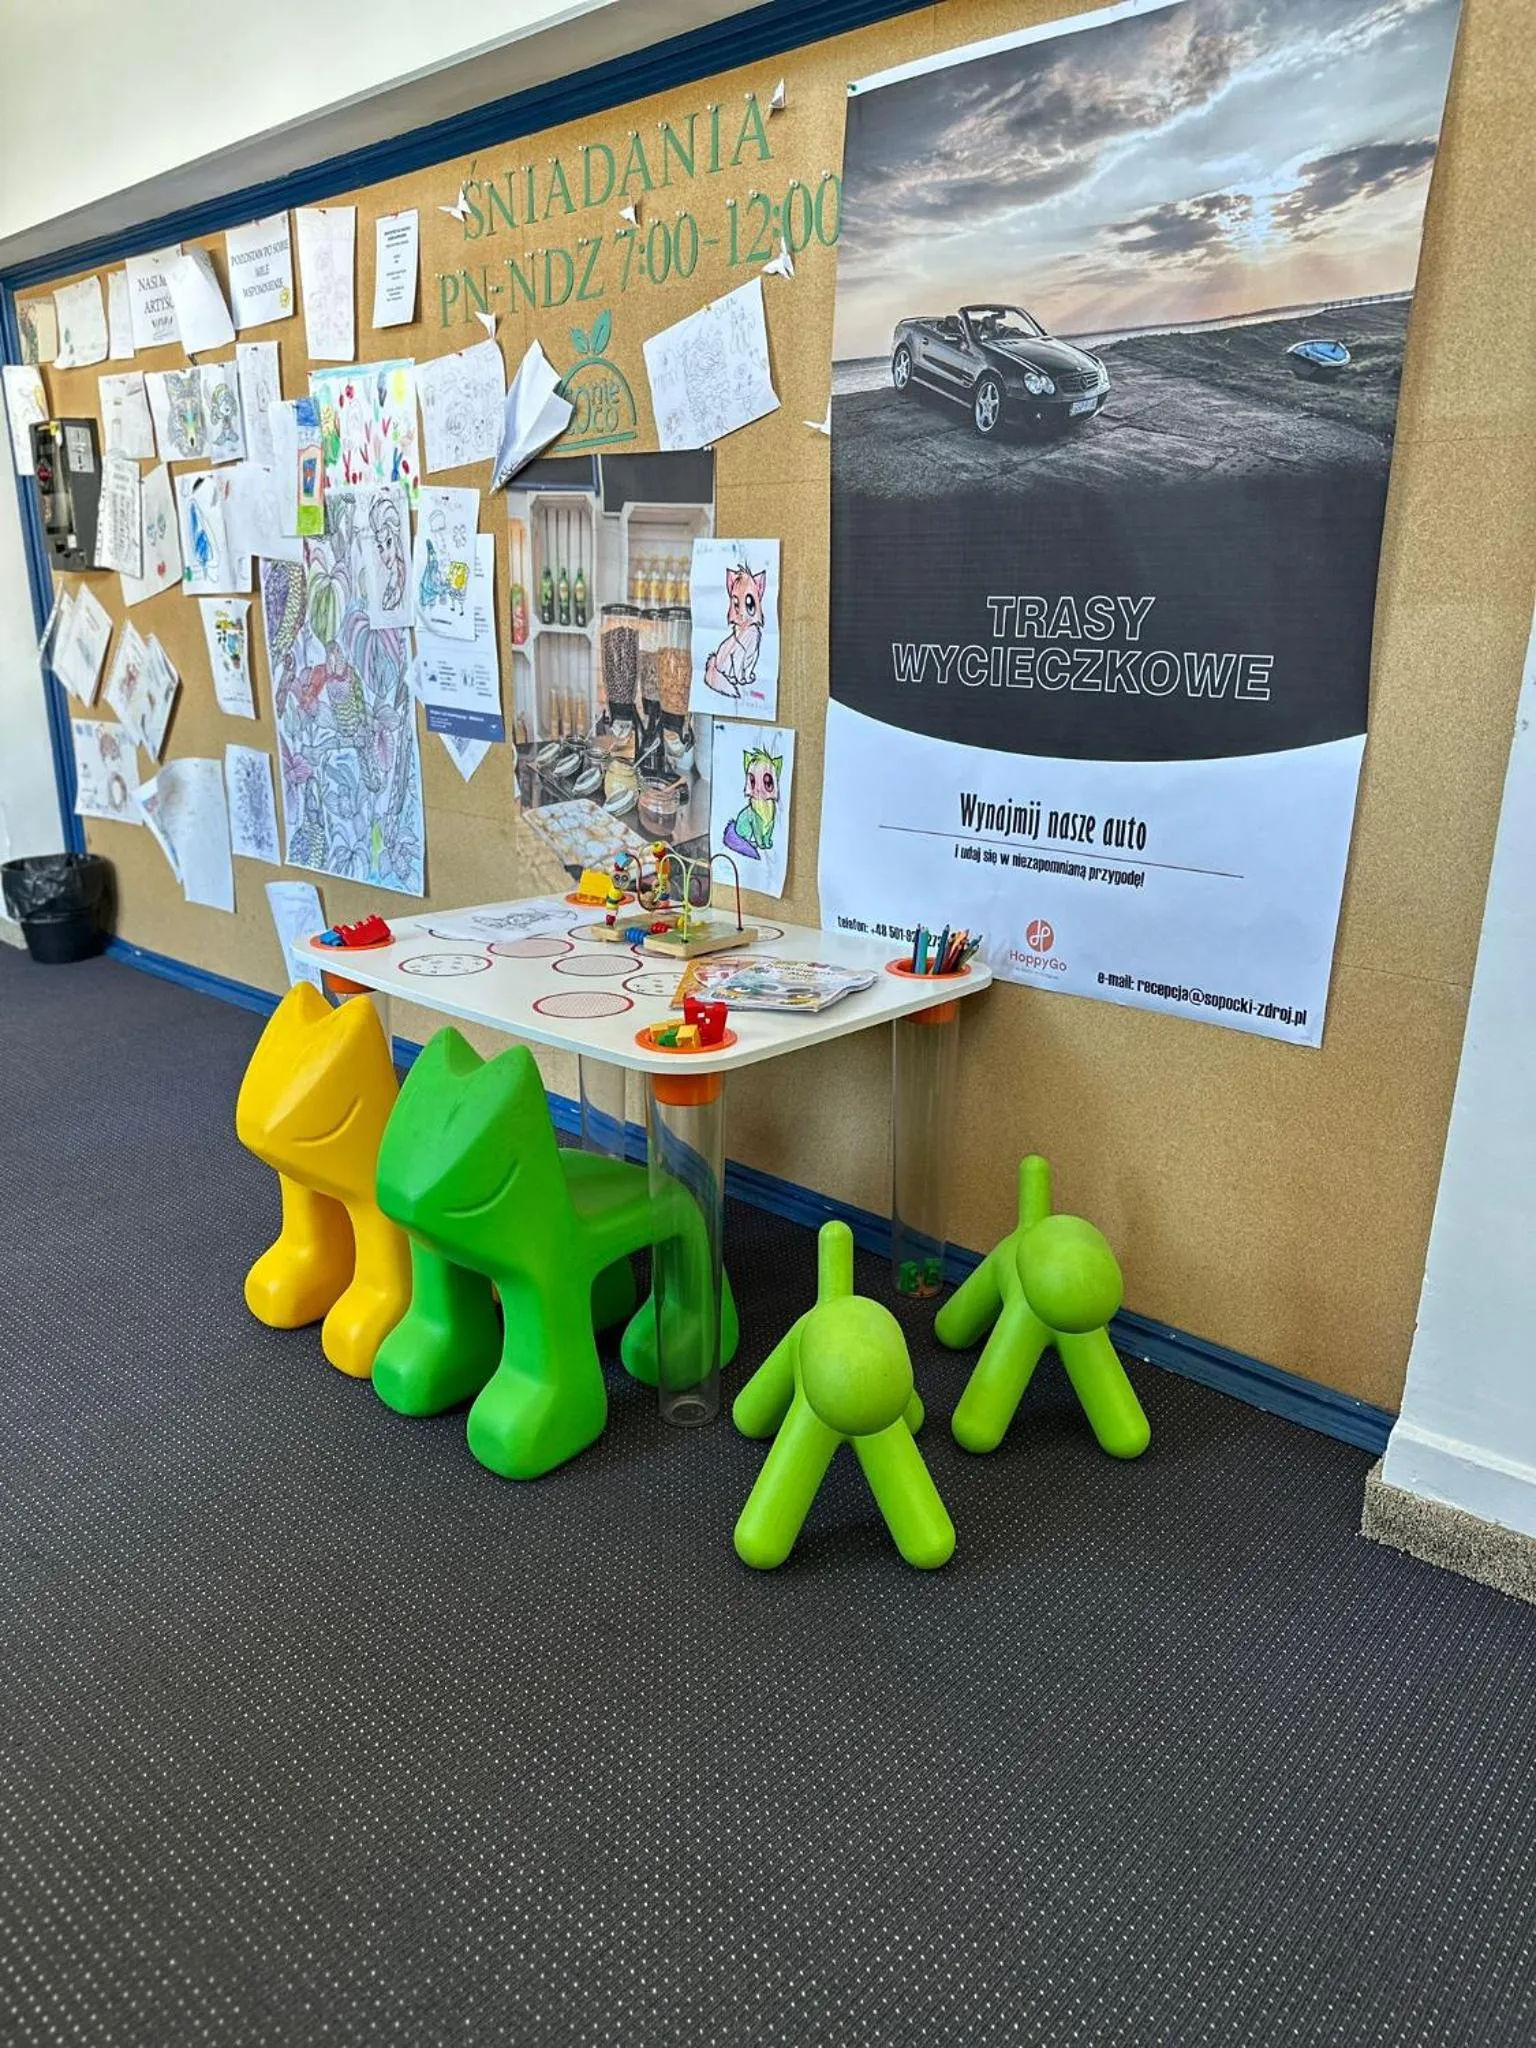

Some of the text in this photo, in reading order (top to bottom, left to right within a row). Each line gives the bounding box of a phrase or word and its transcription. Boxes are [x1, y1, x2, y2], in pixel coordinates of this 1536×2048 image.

[463, 95, 774, 241] ŚNIADANIA
[437, 236, 604, 328] PN-NDZ
[986, 596, 1156, 640] TRASY
[892, 643, 1274, 700] WYCIECZKOWE
[960, 792, 1147, 850] Wynajmij nasze auto
[960, 846, 981, 863] udaj
[983, 848, 997, 865] się
[1000, 852, 1009, 865] w
[1012, 852, 1086, 880] niezapomnianą
[1088, 867, 1145, 888] przygodę!
[837, 915, 869, 933] telefon:
[1010, 950, 1067, 972] HoppyGo
[1097, 971, 1134, 990] e-mail:
[1136, 978, 1307, 1026] recepcja@sopocki-zdroj.pl
